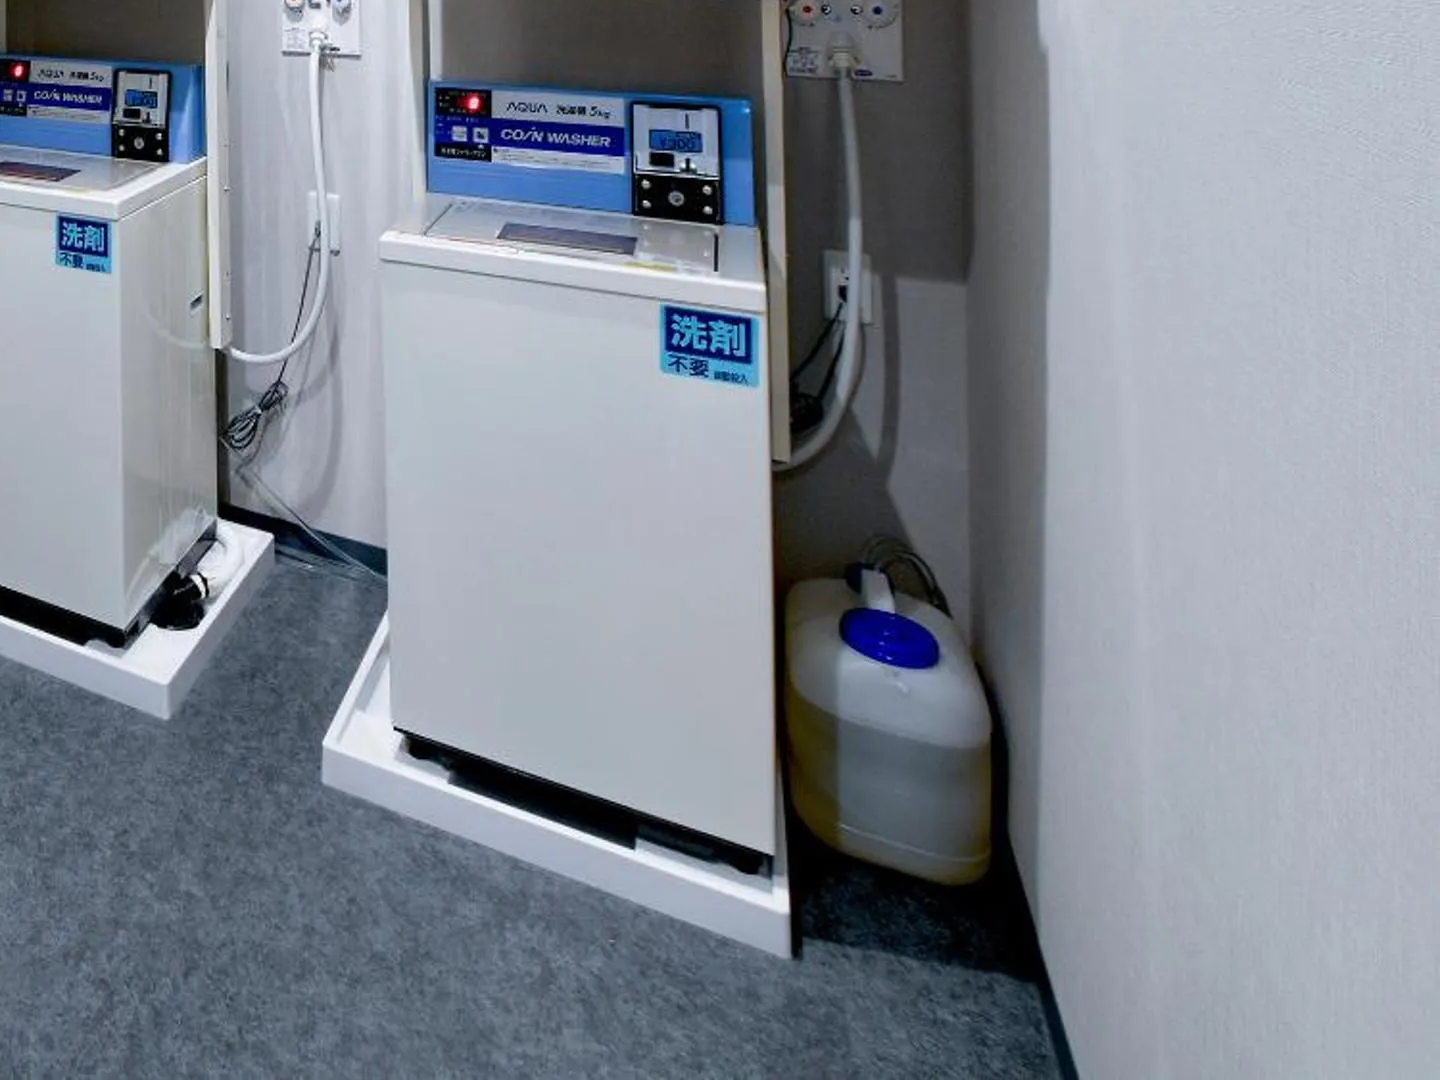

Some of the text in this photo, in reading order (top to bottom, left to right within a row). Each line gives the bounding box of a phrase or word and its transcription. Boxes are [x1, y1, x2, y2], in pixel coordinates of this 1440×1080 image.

[506, 101, 548, 113] AQUA
[500, 126, 612, 148] COIN WASHER
[61, 221, 105, 252] 洗剤
[671, 313, 746, 357] 洗剤
[667, 353, 709, 378] 不要
